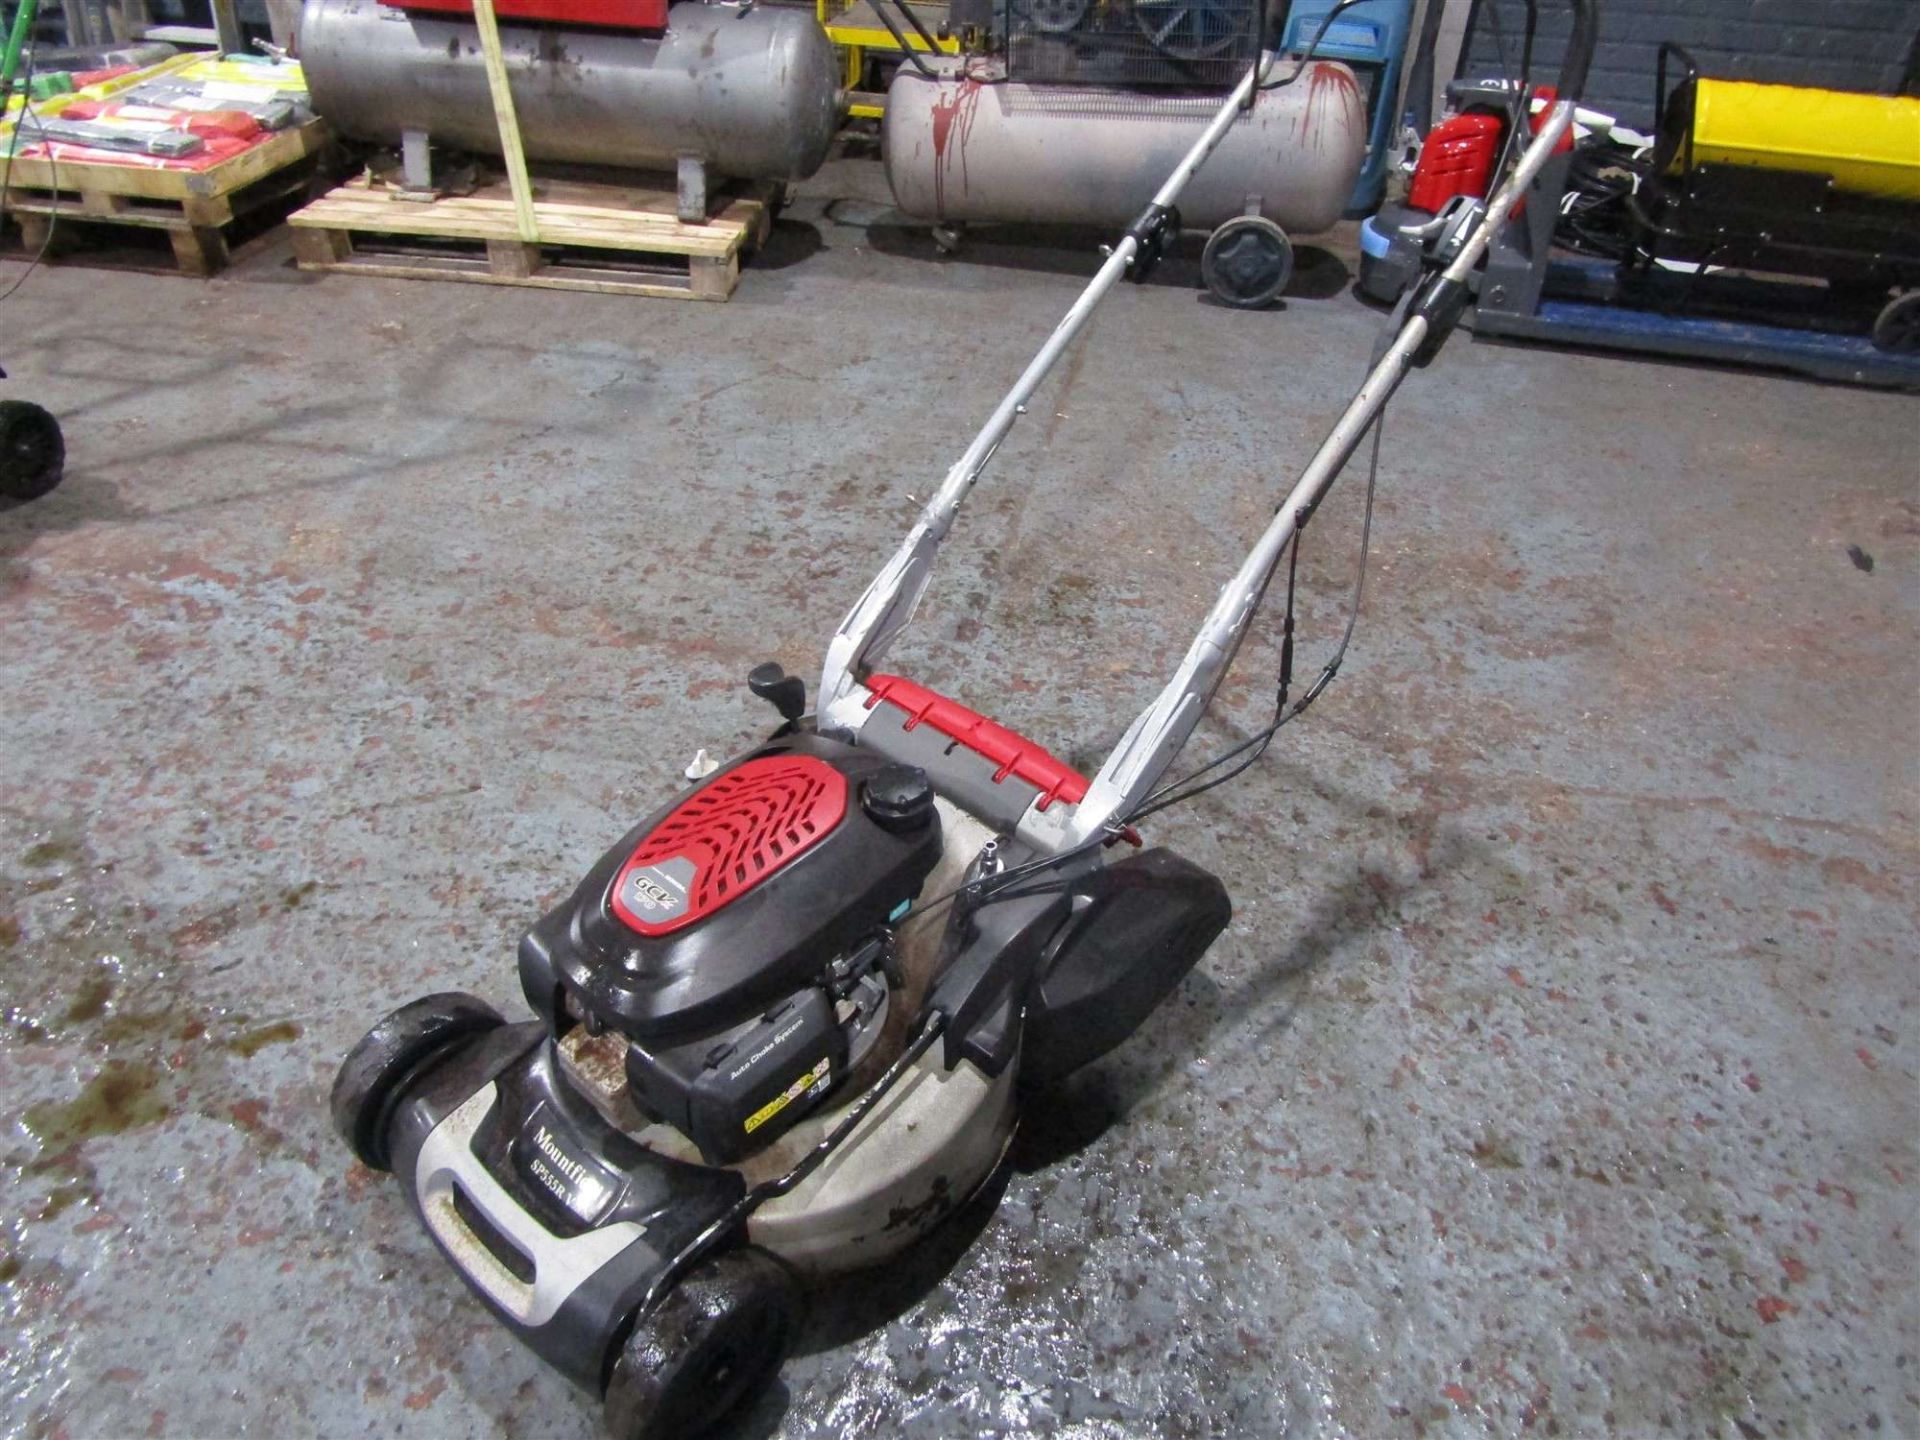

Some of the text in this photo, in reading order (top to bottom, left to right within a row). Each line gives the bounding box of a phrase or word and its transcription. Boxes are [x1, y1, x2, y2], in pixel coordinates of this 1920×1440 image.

[730, 1061, 751, 1081] Auto
[750, 1041, 775, 1065] Choke
[530, 1159, 566, 1201] SP555R
